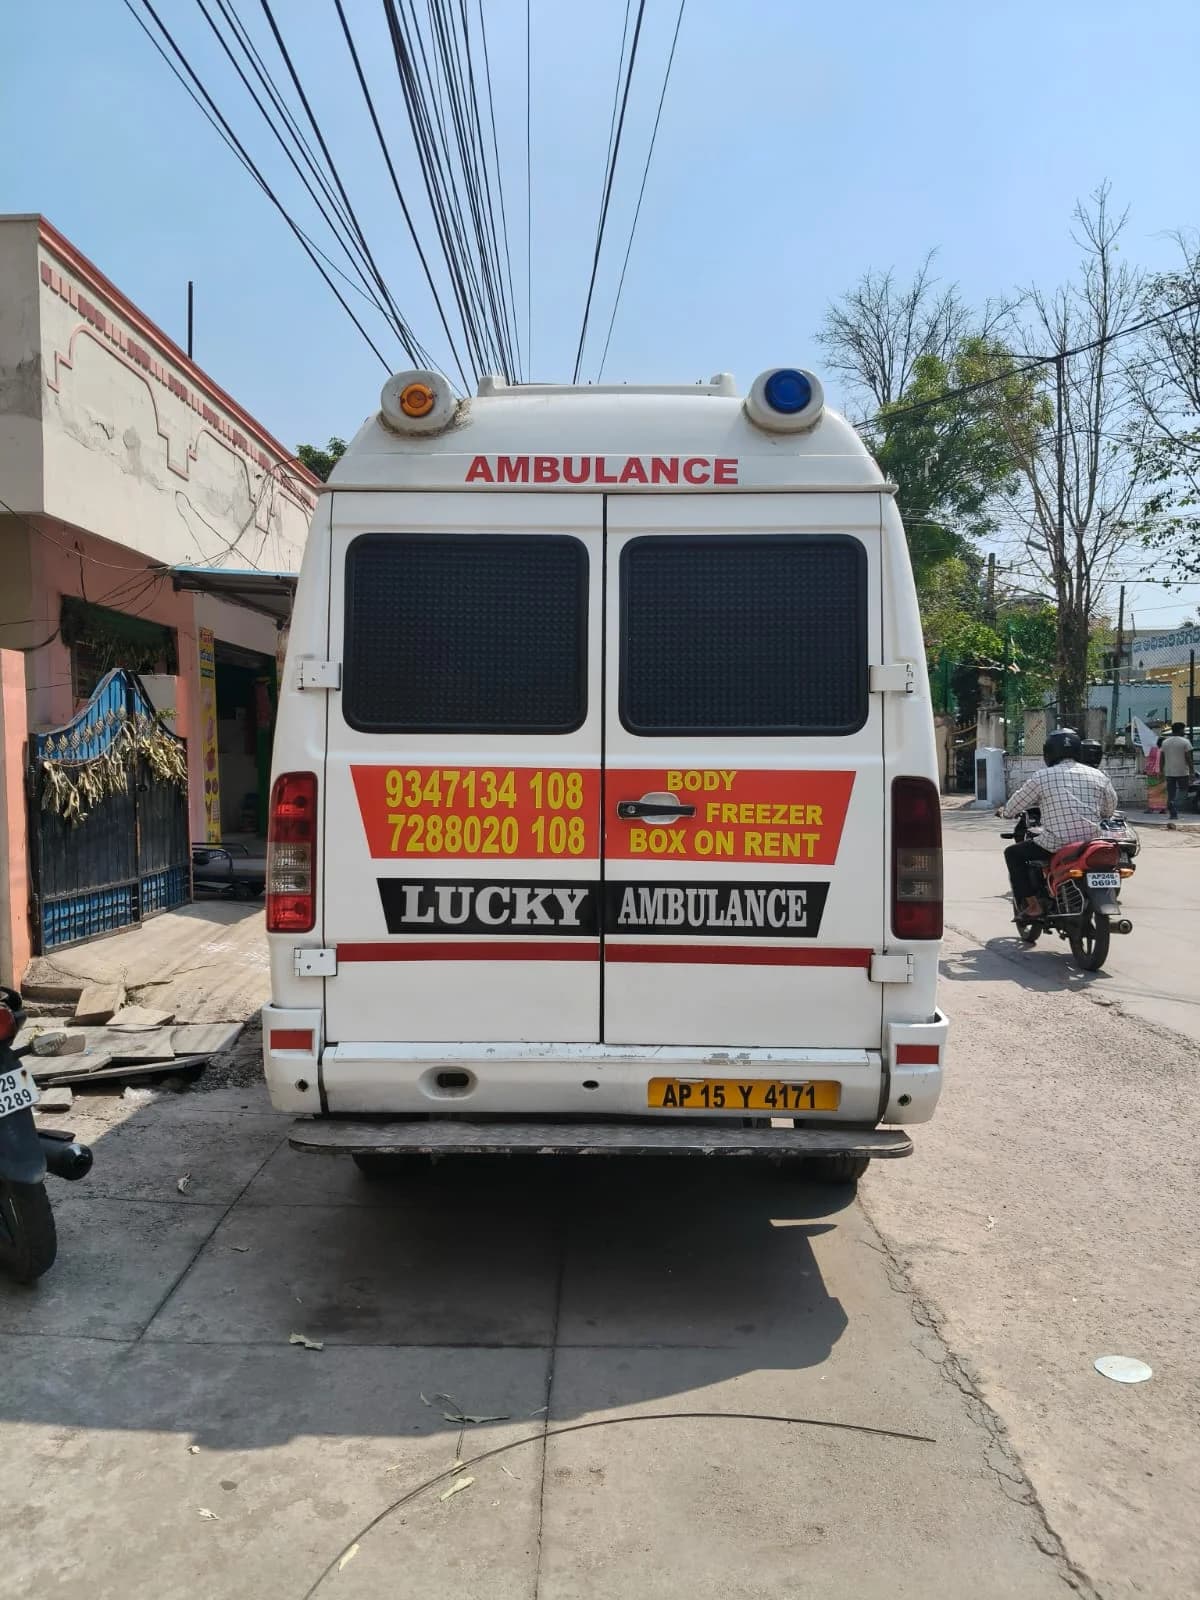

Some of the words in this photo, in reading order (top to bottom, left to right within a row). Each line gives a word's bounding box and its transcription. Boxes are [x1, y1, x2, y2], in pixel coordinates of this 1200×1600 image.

[465, 456, 739, 485] AMBULANCE
[385, 769, 517, 808] 9347134
[529, 772, 584, 809] 108
[667, 771, 737, 791] BODY
[706, 803, 824, 825] FREEZER
[388, 814, 519, 854] 7288020
[531, 816, 585, 855] 108
[630, 829, 687, 854] BOX
[694, 831, 735, 855] ON
[744, 832, 821, 857] RENT
[401, 885, 589, 926] LUCKY
[617, 887, 807, 927] AMBULANCE
[662, 1084, 692, 1107] AP
[700, 1085, 726, 1108] 15
[738, 1085, 753, 1108] Y
[764, 1084, 816, 1109] 4171
